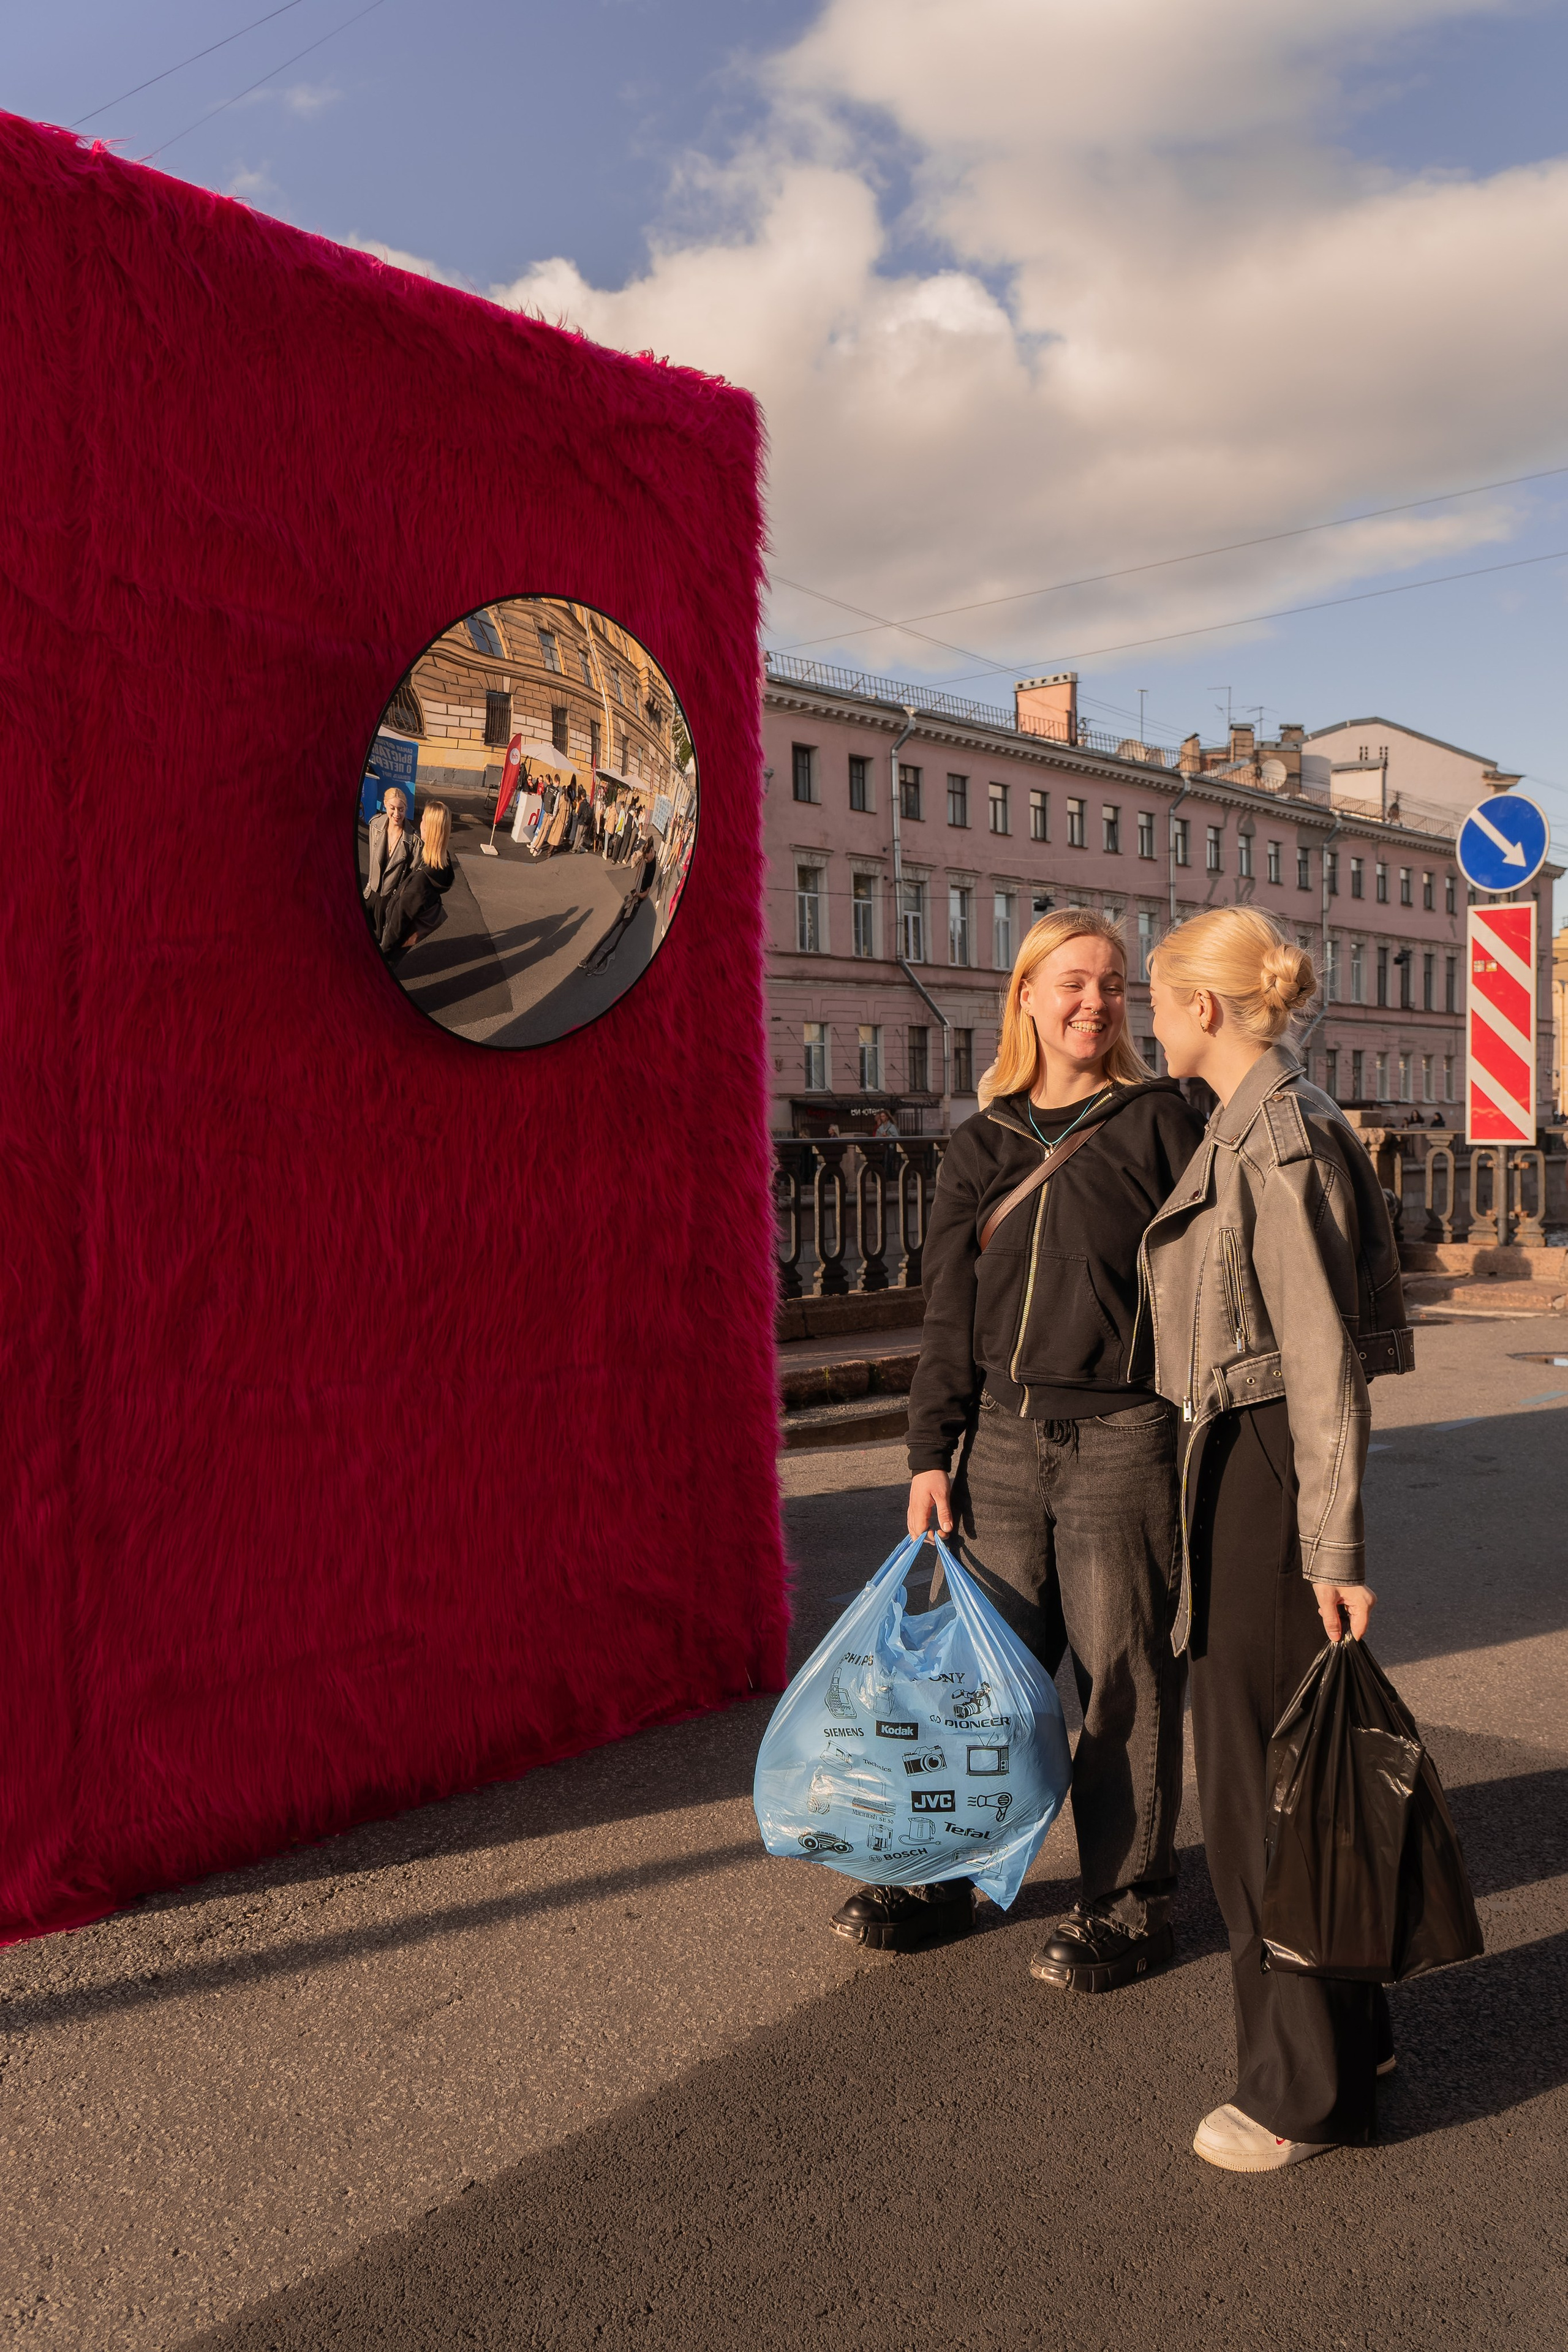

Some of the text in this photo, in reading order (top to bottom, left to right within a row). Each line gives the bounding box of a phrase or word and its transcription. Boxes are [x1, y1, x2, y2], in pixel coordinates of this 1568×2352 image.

[944, 1717, 1010, 1728] PIONEER
[823, 1727, 865, 1737] SIEMENS
[881, 1724, 914, 1736] Kodak
[913, 1794, 952, 1809] JVC
[944, 1821, 992, 1839] Tefal
[883, 1847, 929, 1860] BOSCH
